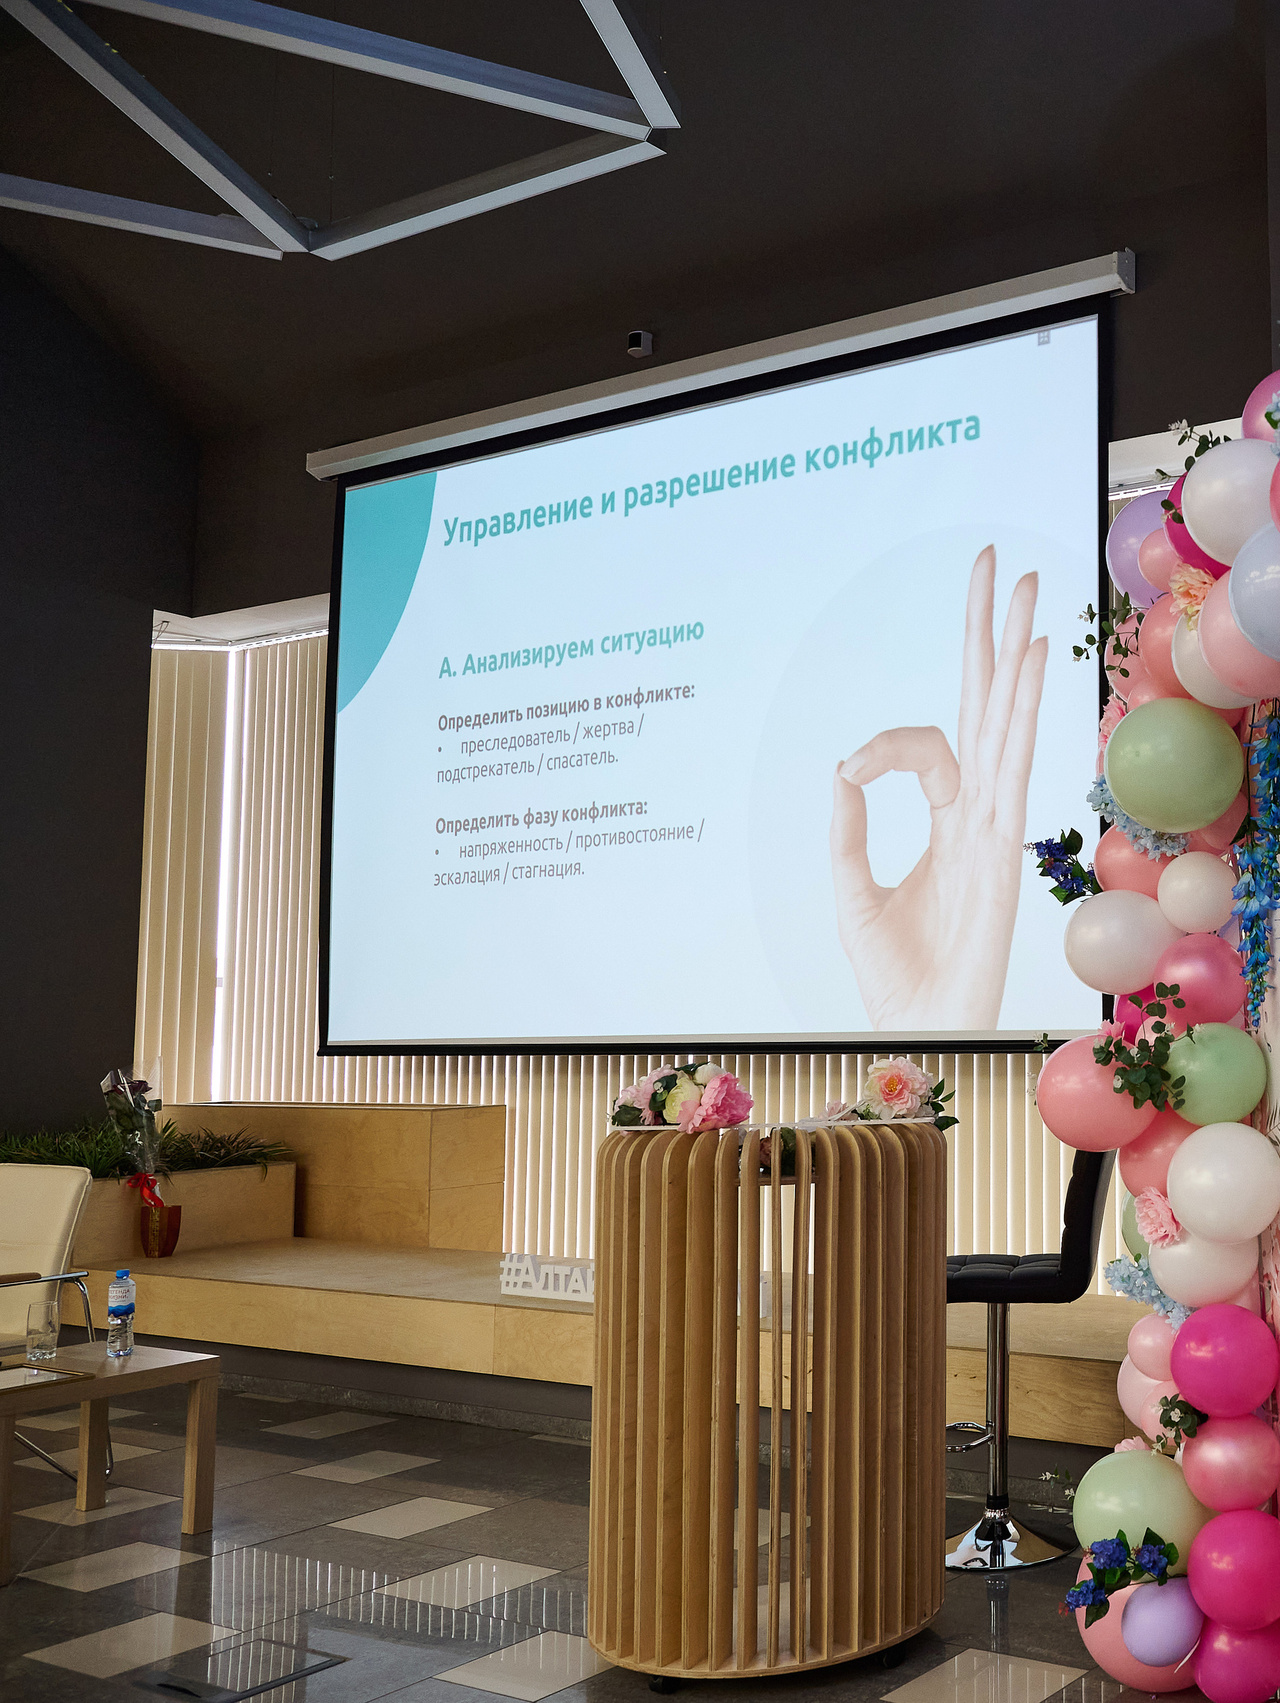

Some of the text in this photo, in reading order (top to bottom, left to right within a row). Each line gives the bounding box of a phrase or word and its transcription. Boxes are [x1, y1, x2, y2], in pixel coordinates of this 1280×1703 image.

[443, 415, 981, 548] Управление и разрешение конфликта
[438, 621, 705, 680] А. Анализируем ситуацию
[438, 684, 696, 733] Определить позицию в конфликте:
[460, 726, 571, 757] преследователь
[582, 717, 635, 742] жертва
[436, 759, 535, 785] подстрекатель
[546, 749, 619, 772] спасатель.
[435, 800, 648, 837] Определить фазу конфликта:
[458, 836, 564, 860] напряженность
[575, 825, 695, 853] противостояние
[433, 868, 501, 887] эскалация
[511, 861, 585, 881] стагнация.
